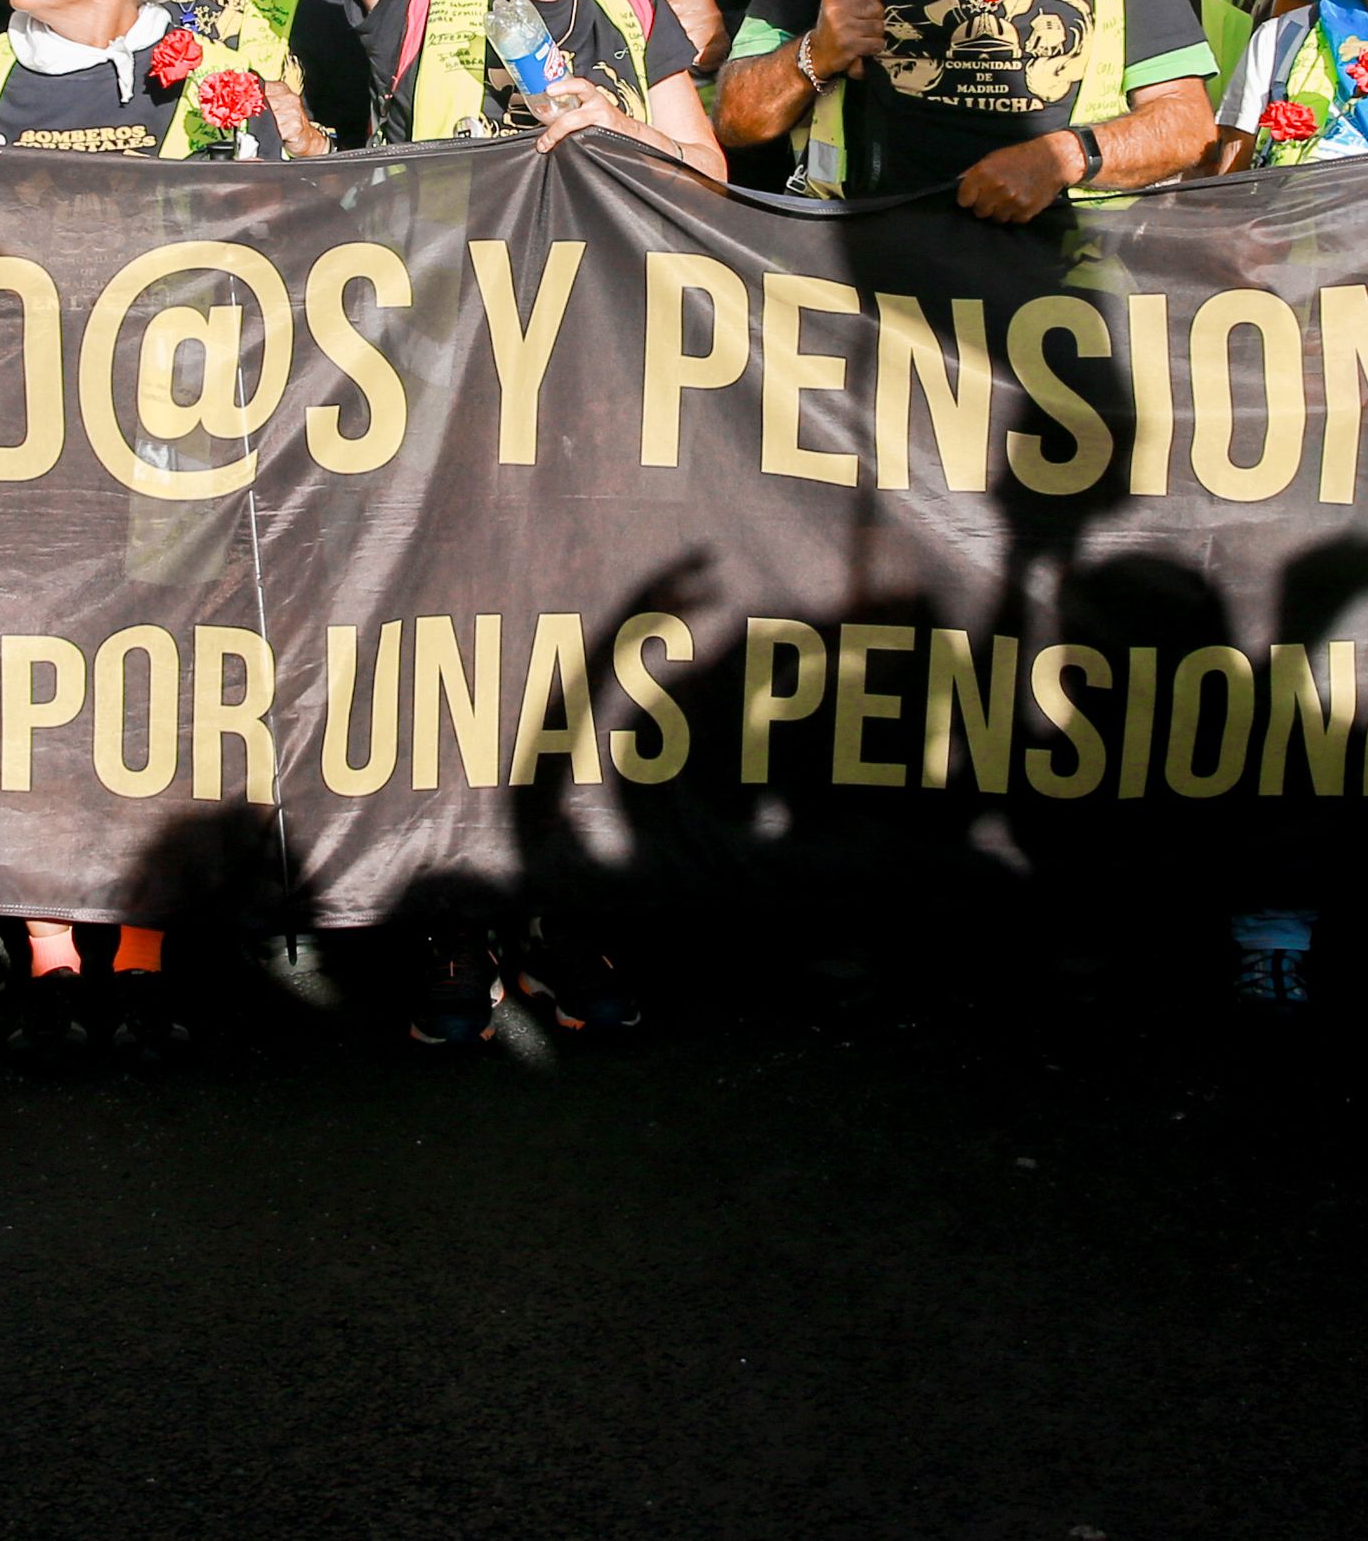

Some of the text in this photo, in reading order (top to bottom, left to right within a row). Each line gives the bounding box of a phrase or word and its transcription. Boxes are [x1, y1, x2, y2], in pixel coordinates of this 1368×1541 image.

[945, 60, 1023, 71] COMUNIDAD
[976, 72, 994, 82] DE
[956, 84, 1010, 94] MADRID
[19, 125, 147, 144] BOMBEROS
[468, 239, 587, 466] Y
[0, 622, 278, 806] POR
[321, 611, 696, 796] UNAS
